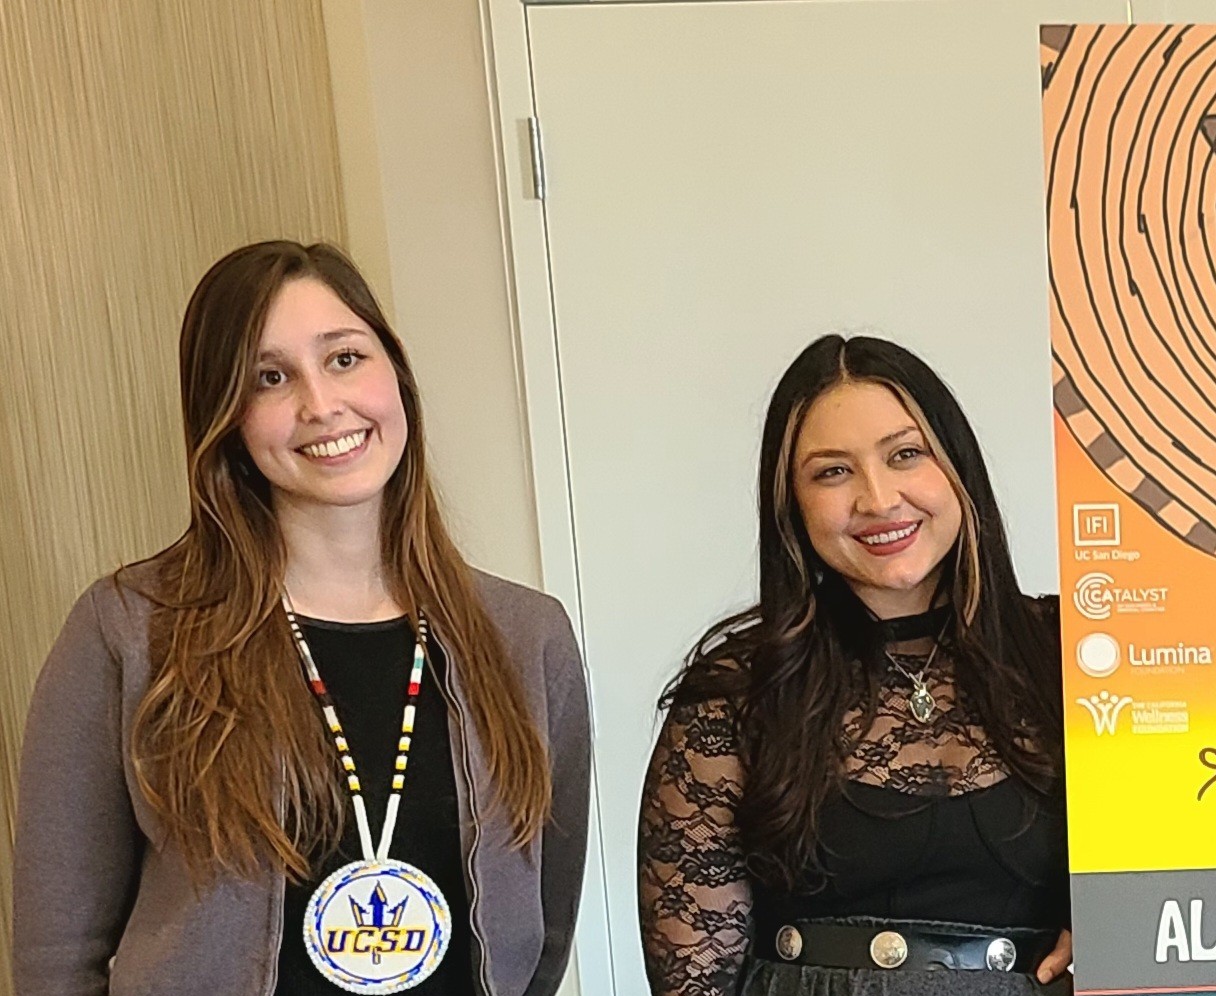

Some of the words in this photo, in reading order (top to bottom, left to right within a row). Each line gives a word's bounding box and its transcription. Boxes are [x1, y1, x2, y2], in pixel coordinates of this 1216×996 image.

[1086, 516, 1108, 534] IFI
[1075, 550, 1091, 561] UC
[1092, 550, 1110, 561] San
[1112, 550, 1141, 562] Diego
[1091, 588, 1168, 603] CATALYST
[1129, 643, 1212, 666] Lumina
[326, 928, 426, 953] UCSD
